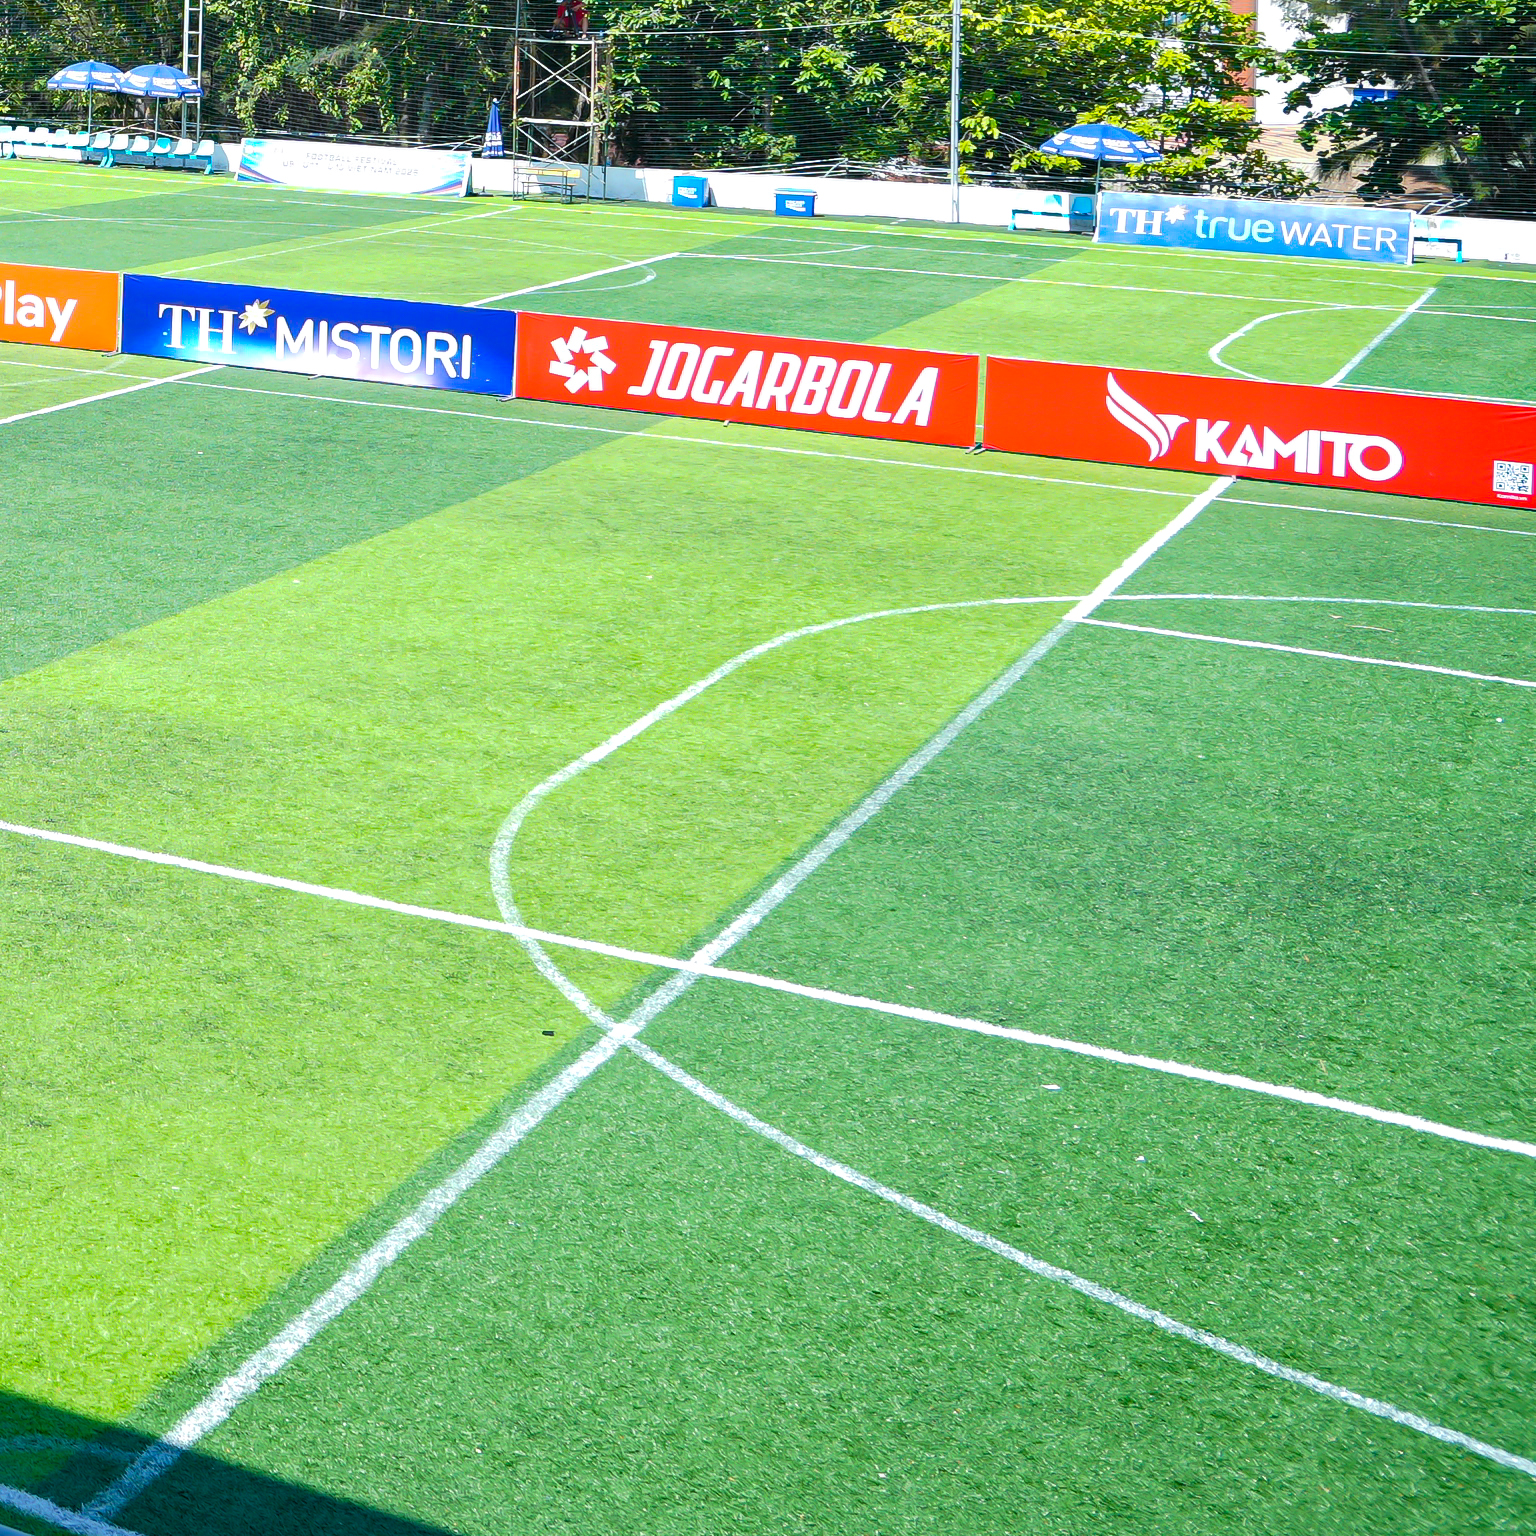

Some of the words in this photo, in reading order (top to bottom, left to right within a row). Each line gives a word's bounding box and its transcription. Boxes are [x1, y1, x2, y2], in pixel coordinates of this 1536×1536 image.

[1110, 208, 1163, 236] TH
[1193, 209, 1274, 243] true
[1280, 220, 1397, 252] WATER
[159, 303, 239, 354] TH
[275, 316, 472, 380] MISTORI
[627, 339, 939, 427] JOGARBOLA
[1194, 418, 1403, 481] KAMITO
